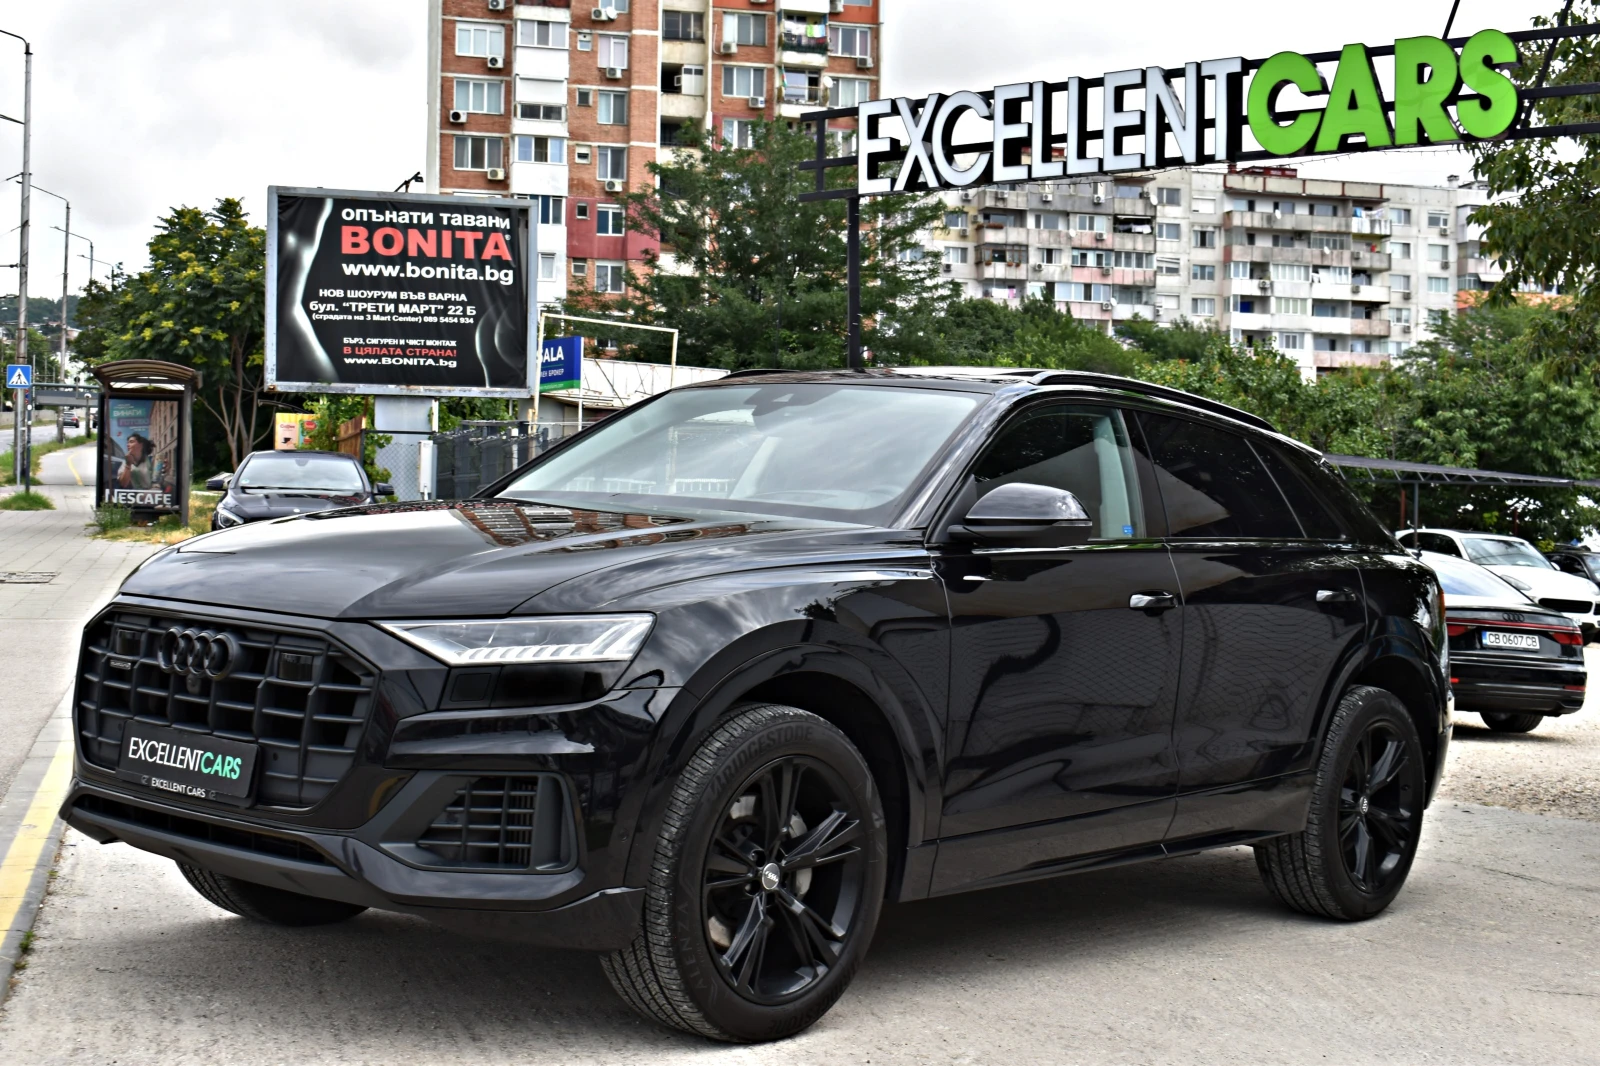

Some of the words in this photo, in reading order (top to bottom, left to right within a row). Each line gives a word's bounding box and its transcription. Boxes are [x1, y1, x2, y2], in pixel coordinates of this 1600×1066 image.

[341, 208, 434, 225] опънати
[440, 213, 510, 229] тавани
[341, 226, 512, 261] BONITA
[342, 262, 513, 284] www.bonita.bg
[320, 289, 344, 297] НОВ
[347, 290, 397, 299] ШОУРУМ
[400, 292, 425, 300] ВЪВ
[429, 293, 467, 301] ВАРНА
[310, 301, 338, 314] бул.
[448, 306, 463, 315] 22
[467, 306, 476, 315] Б
[392, 315, 422, 323] Center)
[343, 337, 366, 345] БЪРЗ,
[343, 346, 353, 355] В
[355, 347, 403, 356] ЦЯЛАТА
[405, 348, 457, 357] СТРАНА!
[344, 357, 457, 368] www.BONITA.bg
[151, 777, 187, 794] EXCELLENT
[186, 786, 206, 798] CARS
